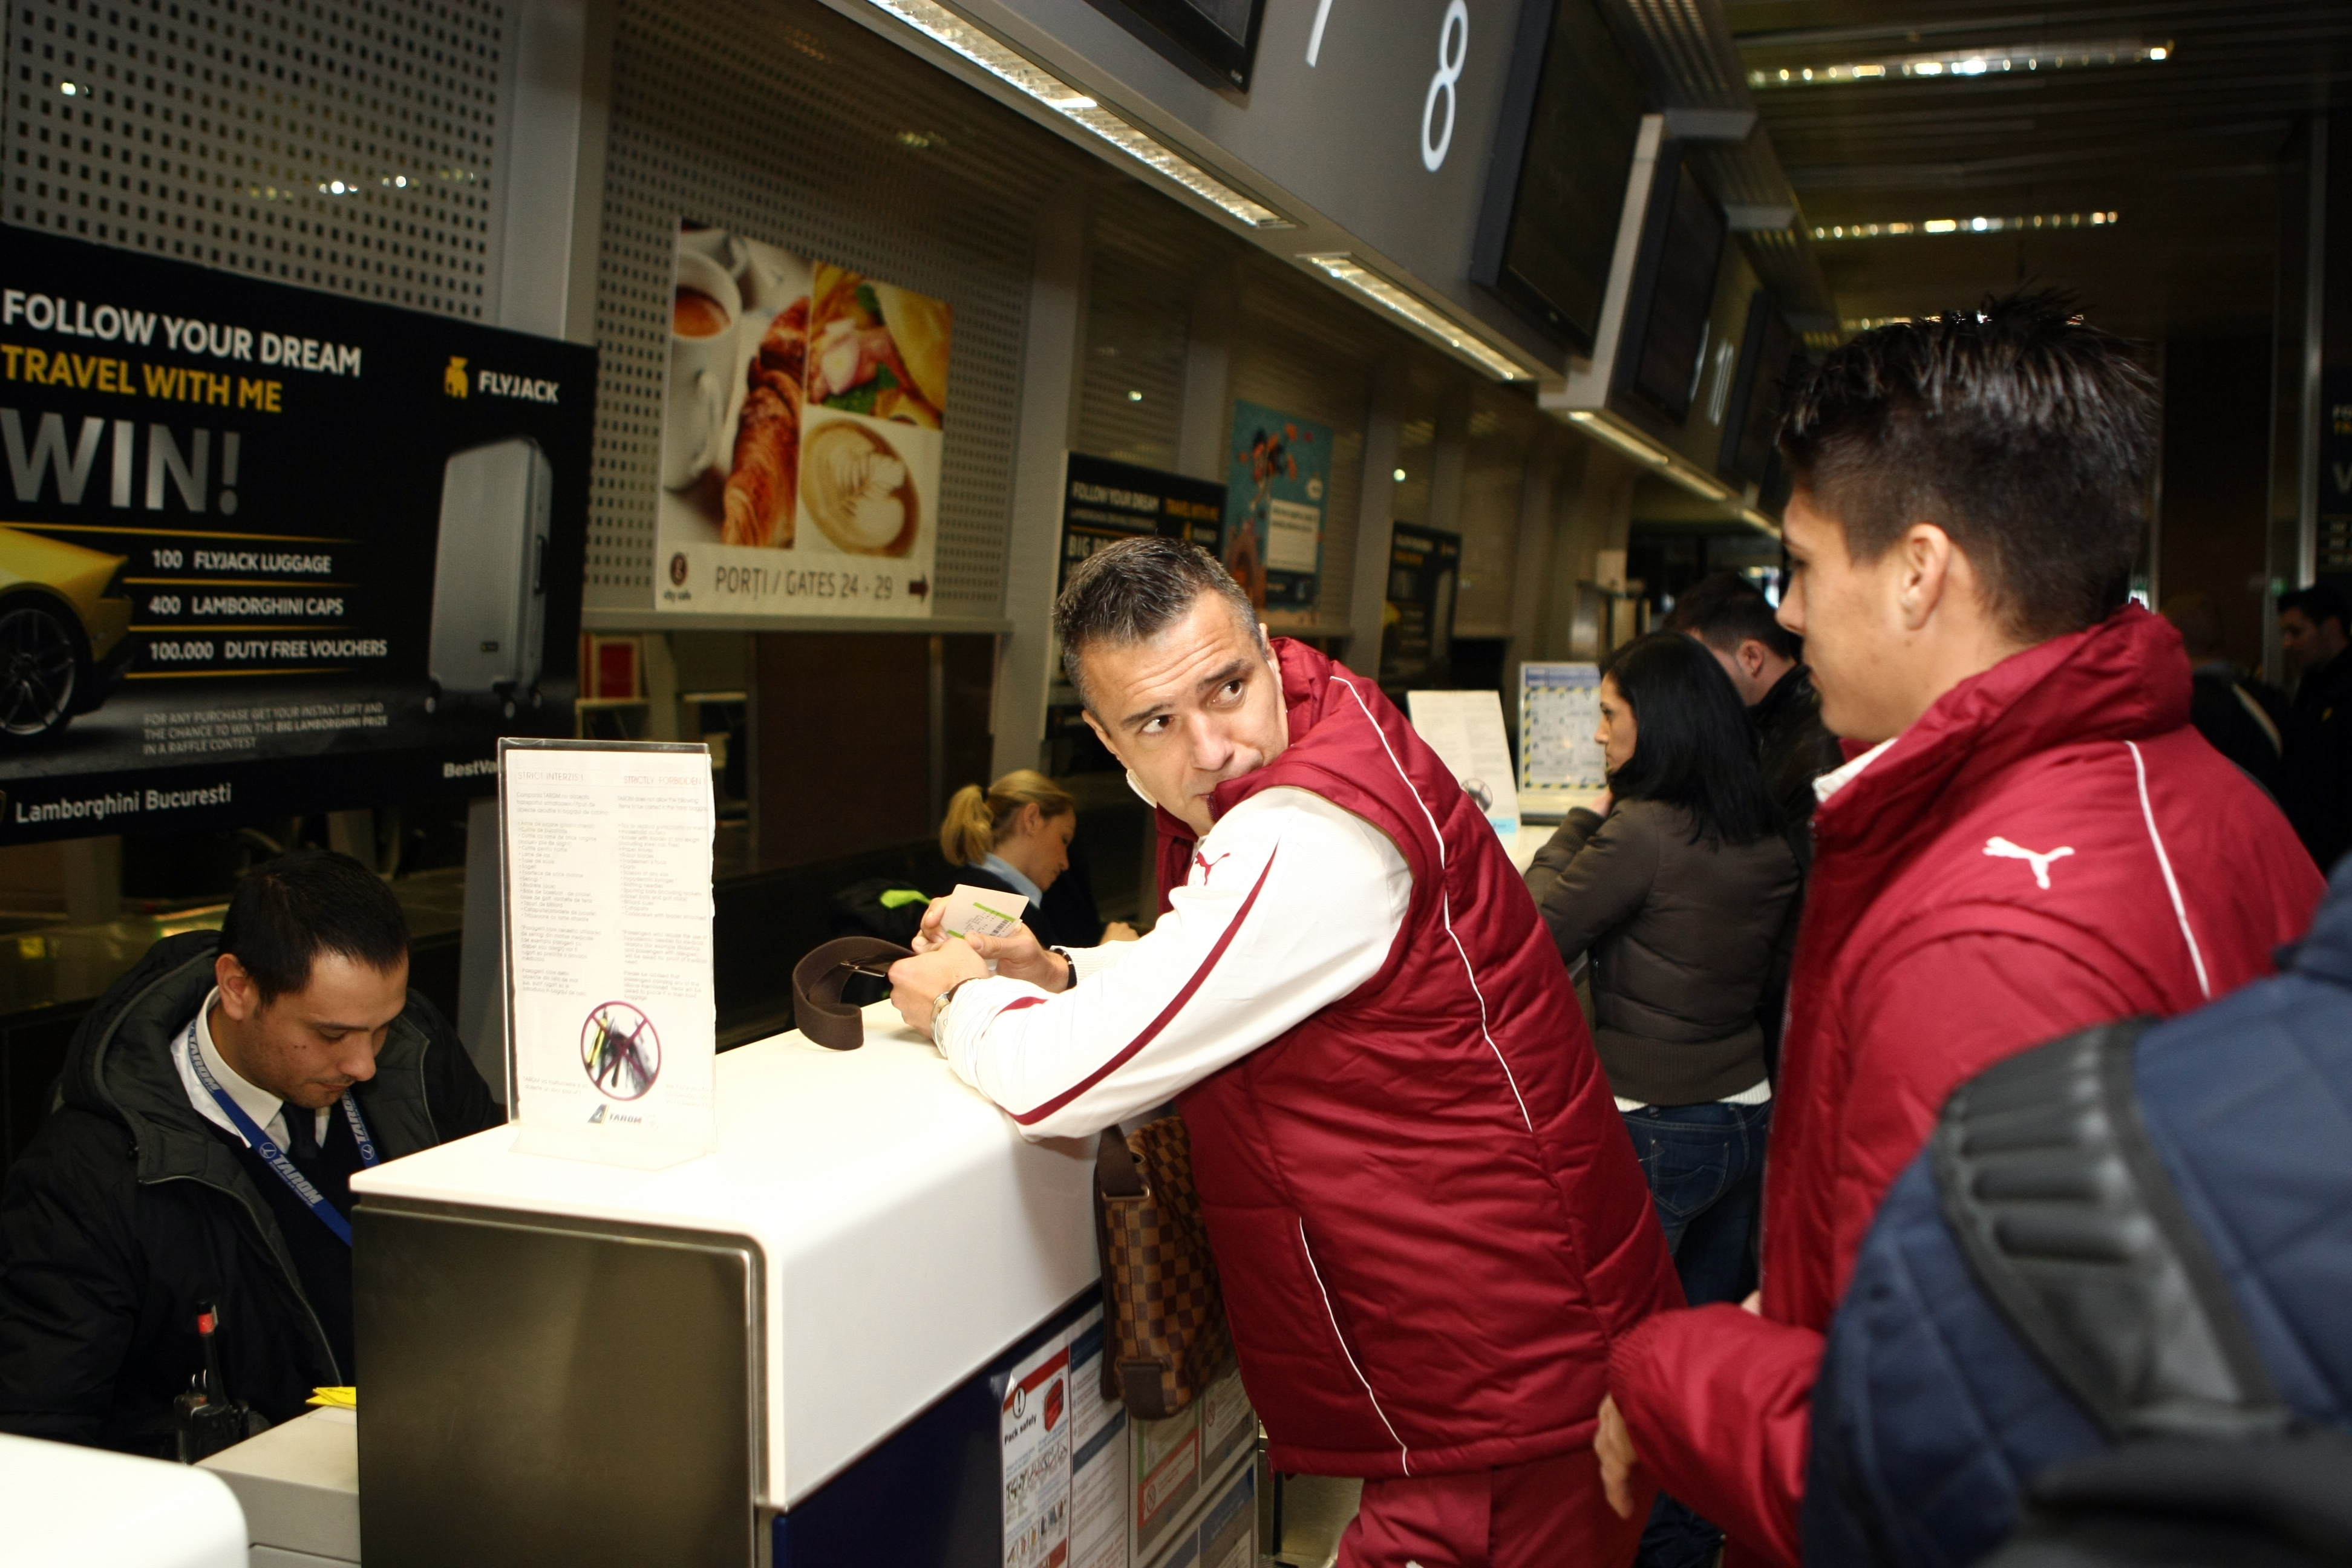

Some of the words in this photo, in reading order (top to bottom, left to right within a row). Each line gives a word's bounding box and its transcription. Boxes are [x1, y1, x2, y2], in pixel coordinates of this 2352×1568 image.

[1422, 0, 1469, 172] 8
[2, 289, 157, 346] FOLLOW
[162, 315, 253, 362] YOUR
[260, 332, 361, 377] DREAM
[0, 343, 137, 395] TRAVEL
[143, 362, 230, 407] WITH
[239, 377, 283, 413] ME
[478, 368, 560, 405] FLYJACK
[0, 407, 240, 517] WIN!
[152, 549, 183, 569] 100
[193, 550, 258, 570] FLYJACK
[261, 554, 332, 573] LUGGAGE
[786, 569, 835, 596] GATES
[840, 573, 858, 598] 24
[875, 575, 893, 599] 29
[149, 596, 181, 615] 400
[192, 596, 304, 615] LAMBORGHINI
[306, 598, 344, 616] CAPS
[149, 641, 214, 661] 100.000
[224, 641, 269, 658] DUTY
[271, 641, 309, 658] FREE
[310, 639, 388, 658] VOUCHERS
[209, 736, 257, 751] CONTEST
[443, 760, 498, 778] BestVa
[624, 776, 655, 785] STRICTLY
[659, 776, 701, 786] FORBIDDEN
[16, 791, 140, 823] Lamborghini
[145, 782, 232, 810] Bucuresti
[189, 1037, 221, 1091] TAROM
[272, 1154, 324, 1204] TAROM
